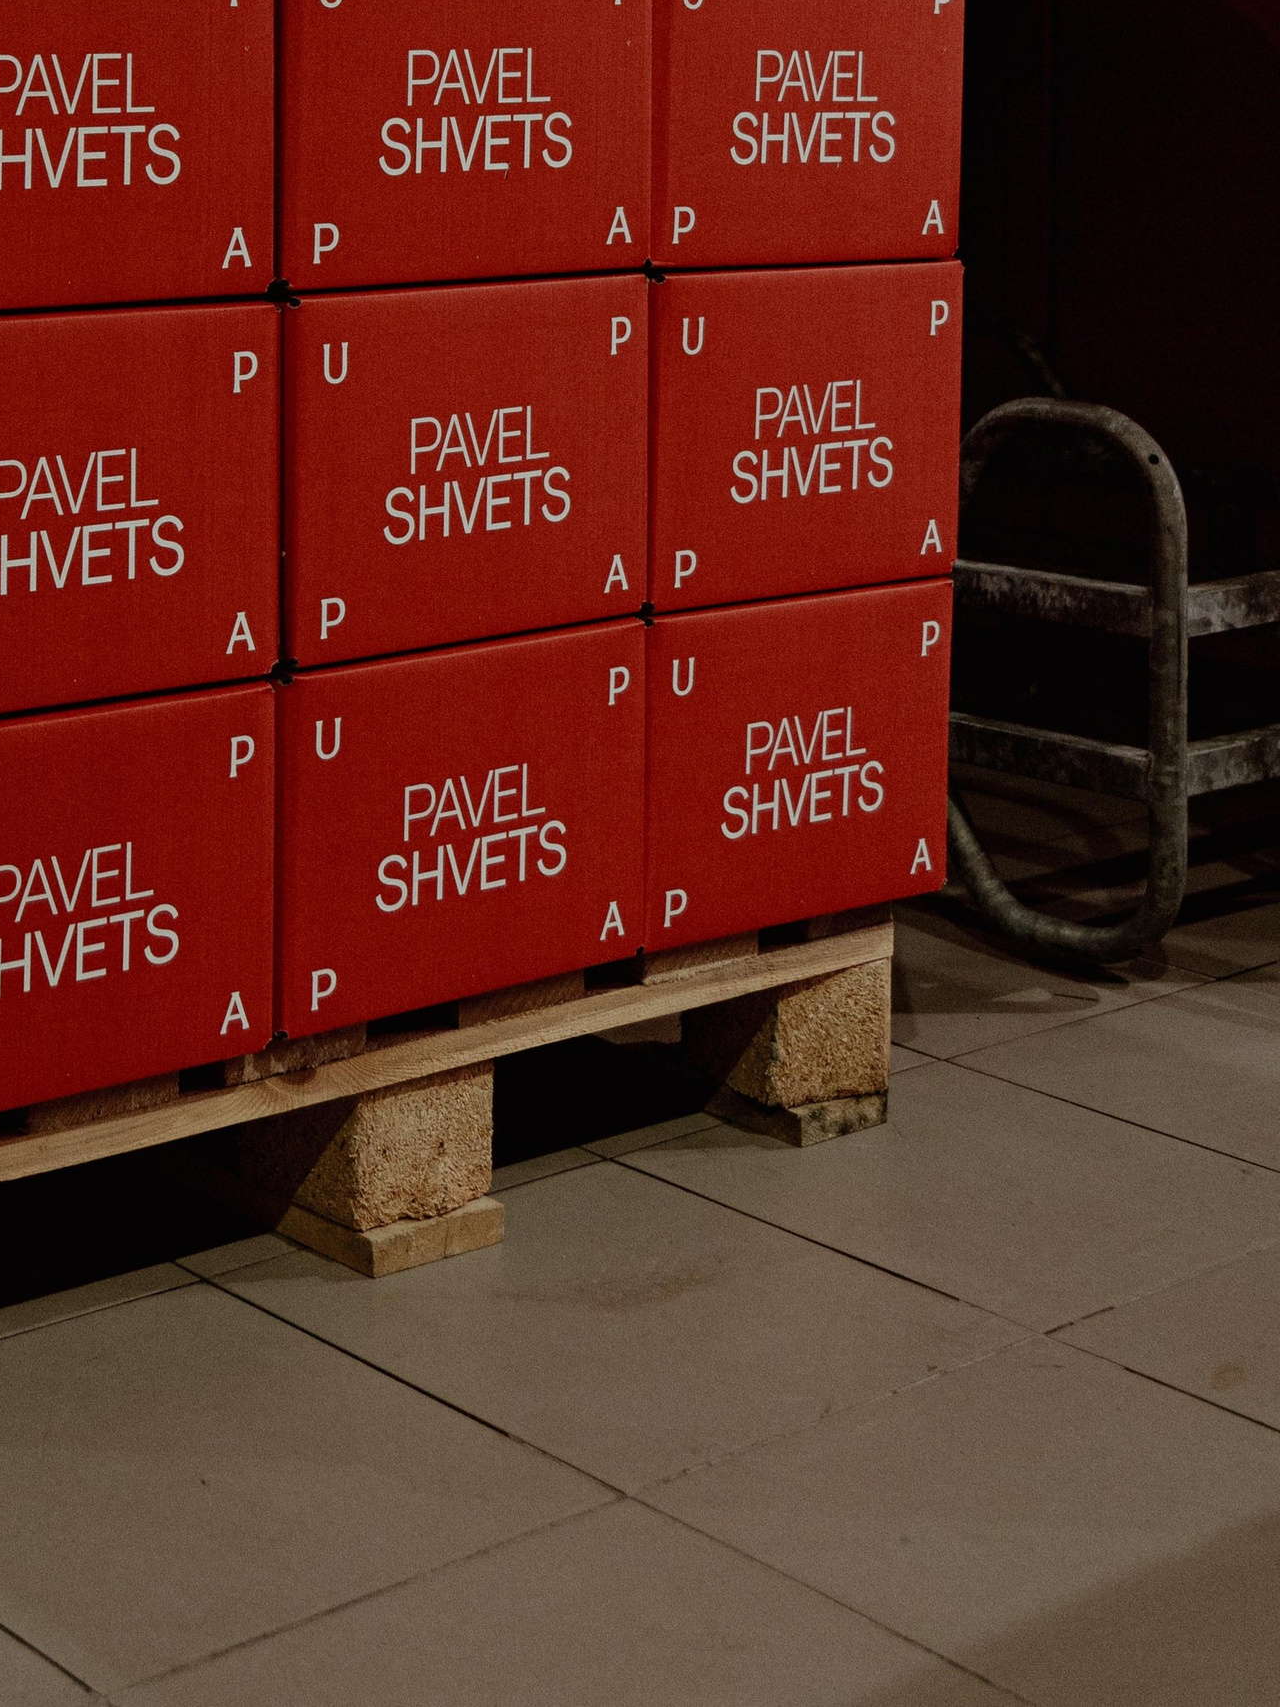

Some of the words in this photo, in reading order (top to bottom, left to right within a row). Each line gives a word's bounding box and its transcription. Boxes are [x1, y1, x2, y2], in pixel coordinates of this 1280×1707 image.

[406, 47, 552, 107] PAVEL
[755, 49, 879, 103] PAVEL
[378, 111, 573, 177] SHVETS
[729, 110, 896, 169] SHVETS
[605, 206, 633, 245] A
[671, 205, 696, 245] P
[921, 199, 945, 236] A
[221, 226, 253, 269] A
[312, 222, 340, 265] P
[610, 315, 632, 356] P
[681, 316, 706, 356] U
[929, 299, 950, 336] P
[232, 350, 259, 394] P
[322, 341, 349, 385] U
[754, 379, 877, 440] PAVEL
[410, 405, 550, 475] PAVEL
[730, 435, 894, 505] SHVETS
[382, 465, 571, 546] SHVETS
[919, 518, 943, 556] A
[603, 553, 629, 594] A
[673, 549, 697, 589] P
[225, 611, 256, 655] A
[319, 597, 346, 640] P
[920, 620, 941, 657] P
[607, 666, 630, 706] P
[672, 656, 696, 697] U
[229, 734, 255, 779] P
[315, 716, 342, 760] U
[745, 705, 867, 775] PAVEL
[403, 762, 546, 842] PAVEL
[720, 760, 885, 840] SHVETS
[375, 819, 567, 913] SHVETS
[909, 837, 932, 875] A
[599, 900, 625, 942] A
[663, 888, 688, 928] P
[310, 968, 338, 1012] P
[219, 990, 250, 1036] A
